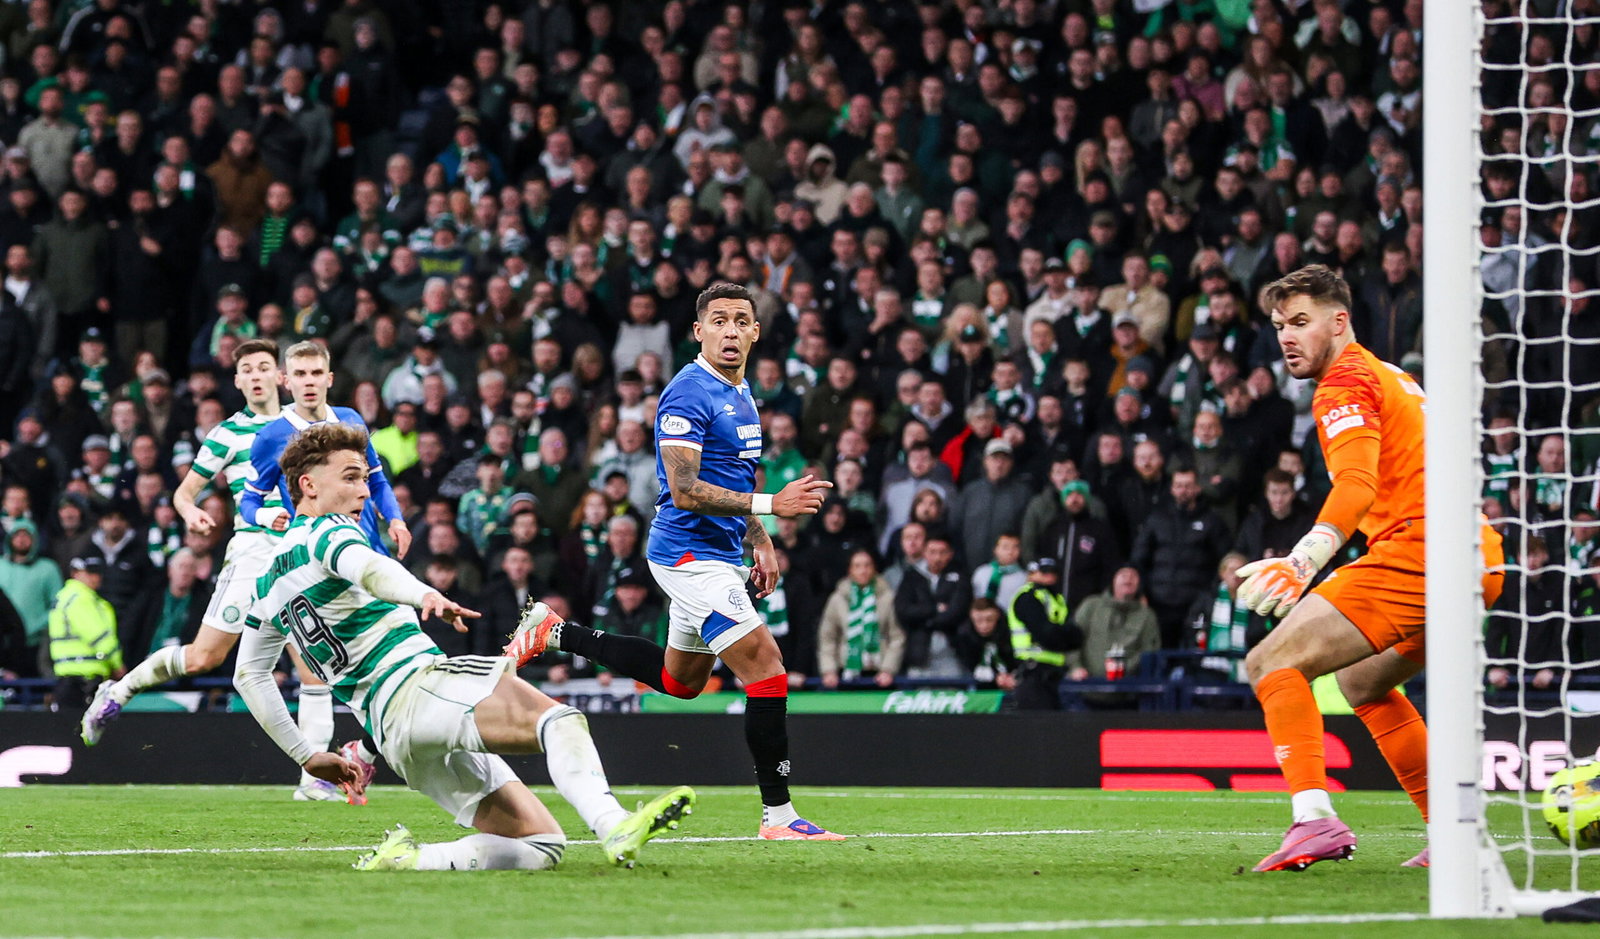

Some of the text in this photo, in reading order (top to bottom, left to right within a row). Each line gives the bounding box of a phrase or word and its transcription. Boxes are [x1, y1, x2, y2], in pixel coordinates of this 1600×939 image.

[1321, 404, 1360, 427] BOXT
[882, 689, 969, 715] Falkirk
[1482, 740, 1600, 791] RE
